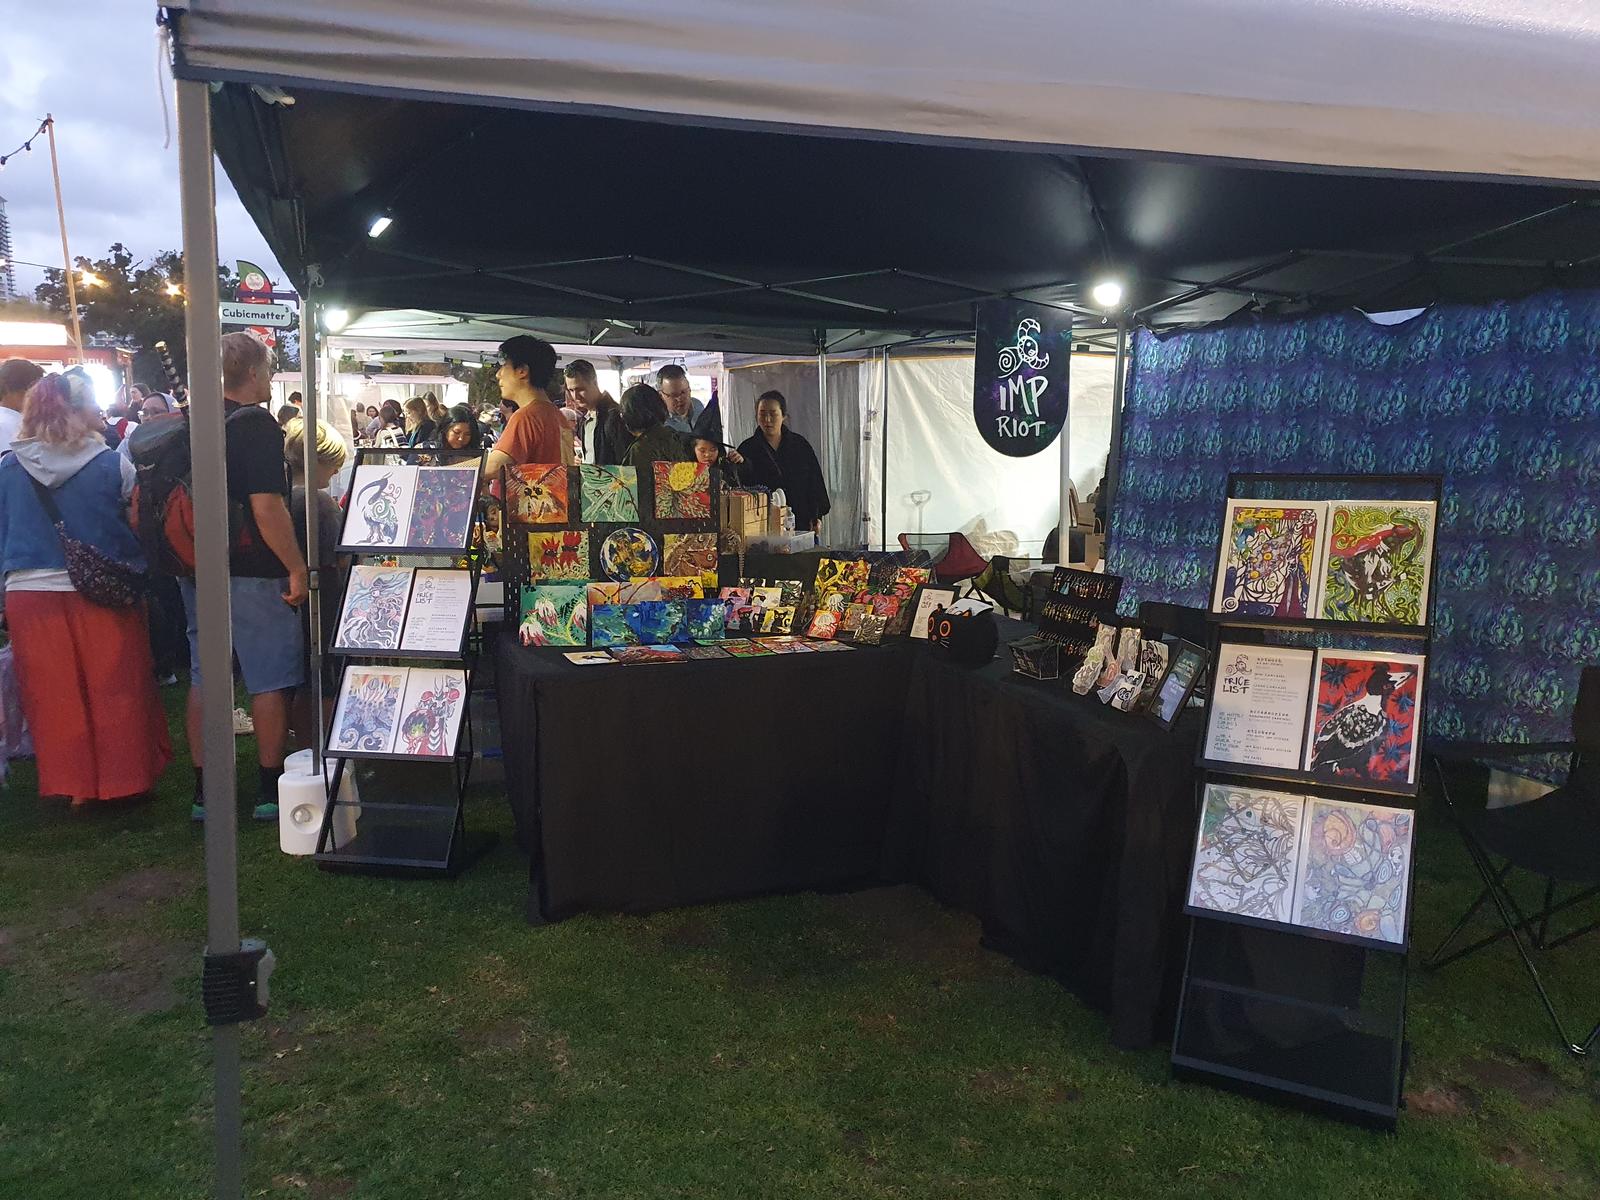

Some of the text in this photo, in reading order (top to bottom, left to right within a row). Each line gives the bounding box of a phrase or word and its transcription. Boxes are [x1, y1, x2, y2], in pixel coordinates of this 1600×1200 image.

[222, 308, 285, 321] Cubicmatter
[999, 374, 1049, 417] IMP
[996, 415, 1047, 438] RIOT
[1224, 675, 1251, 687] PRICE
[1222, 684, 1250, 695] LIST
